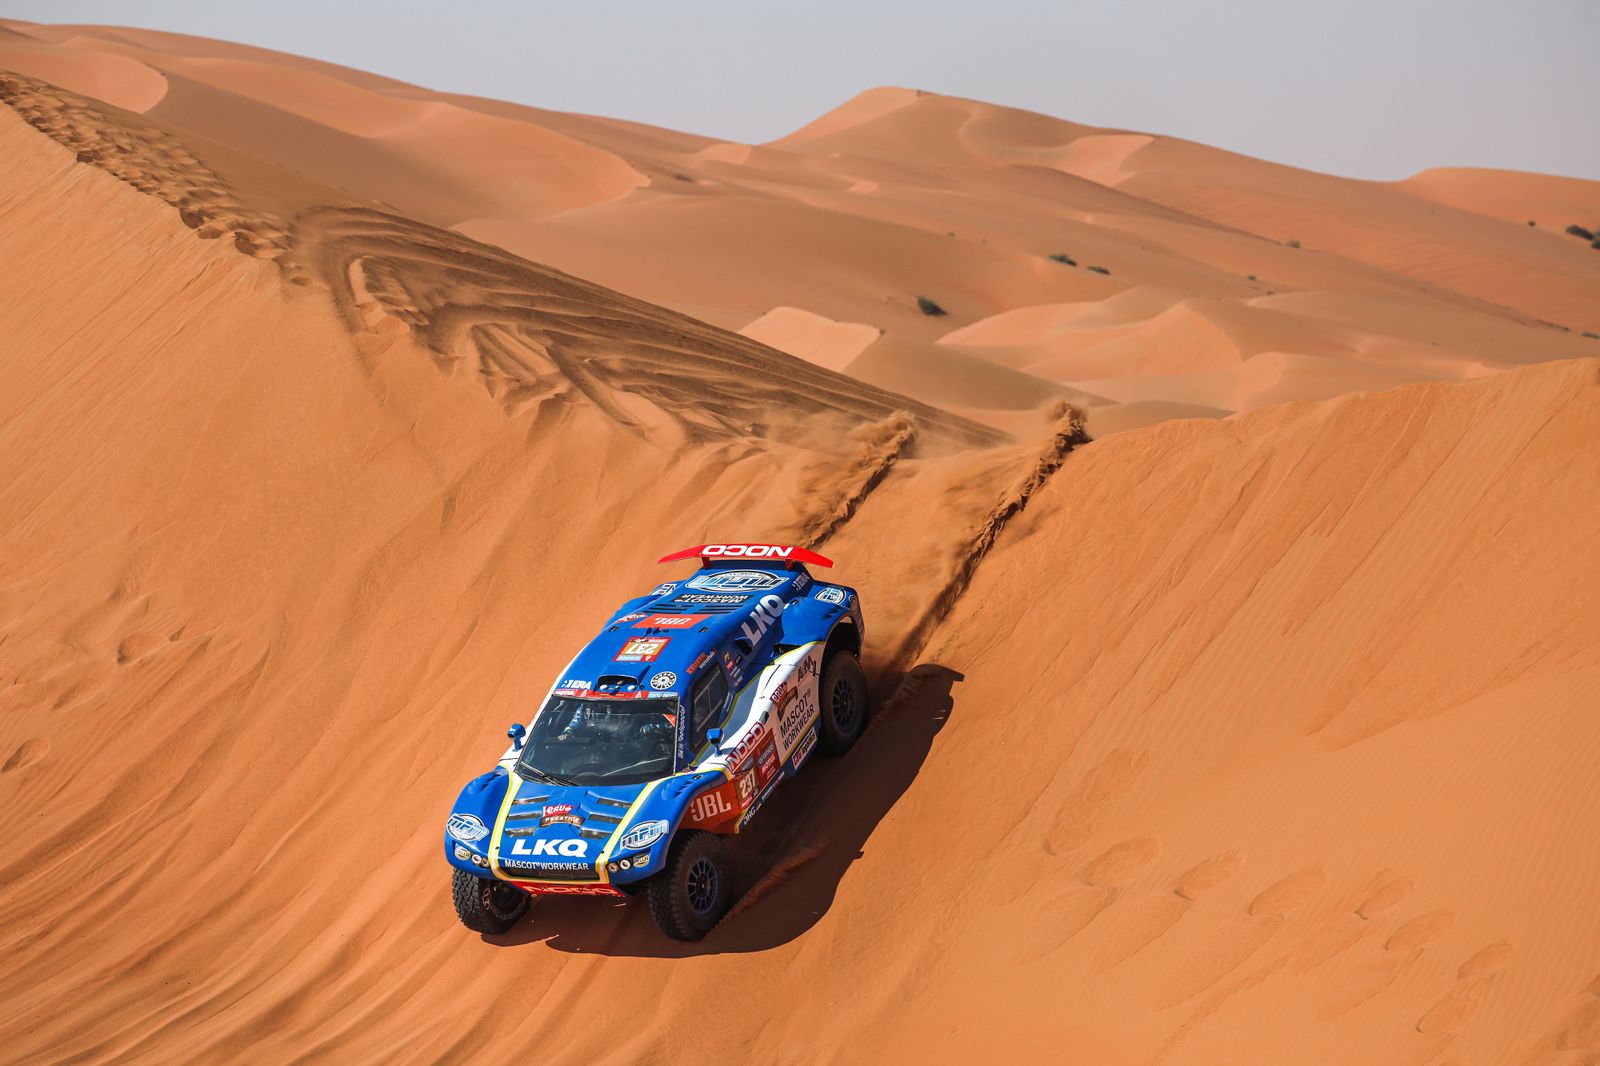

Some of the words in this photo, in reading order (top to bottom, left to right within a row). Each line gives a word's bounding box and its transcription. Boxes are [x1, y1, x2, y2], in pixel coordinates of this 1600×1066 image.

[702, 545, 793, 556] NOCO
[741, 595, 784, 647] LKQ
[625, 643, 660, 655] 237
[783, 704, 815, 750] WORKWEAR
[726, 724, 765, 771] NOCO
[740, 768, 757, 799] 237
[690, 791, 733, 822] JBL
[511, 839, 589, 857] LKQ
[541, 862, 589, 871] WORKWEAR
